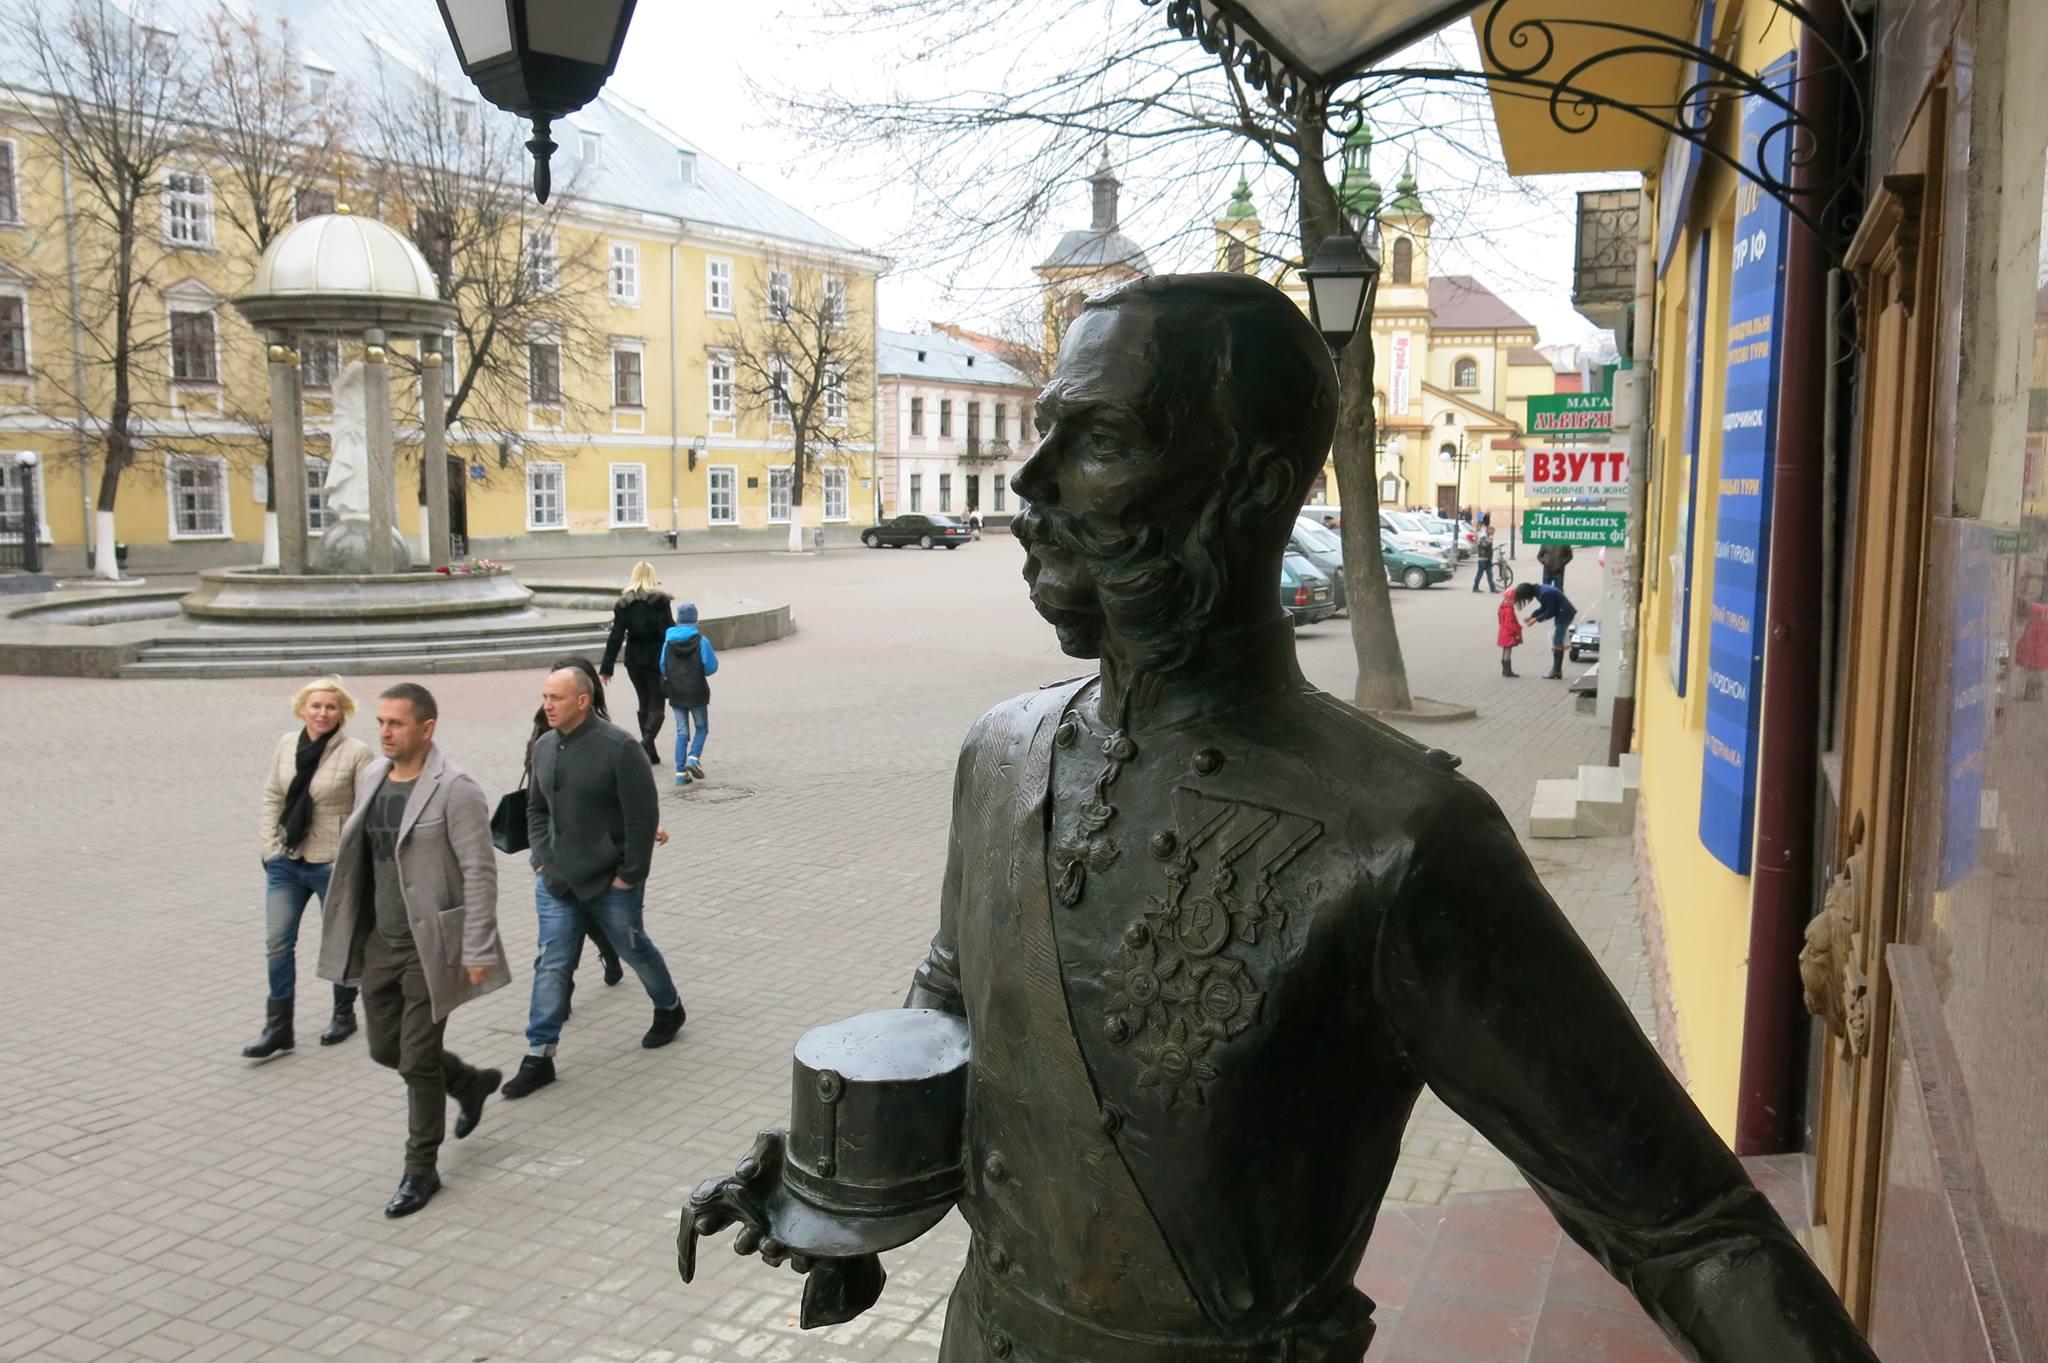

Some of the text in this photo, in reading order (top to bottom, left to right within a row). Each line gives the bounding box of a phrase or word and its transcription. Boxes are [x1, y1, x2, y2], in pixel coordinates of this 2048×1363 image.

[1566, 397, 1613, 408] МАГА
[1533, 452, 1629, 482] ВЗУТТ
[1588, 486, 1600, 494] ТА
[1531, 513, 1618, 527] Львівських
[1609, 529, 1625, 543] фі
